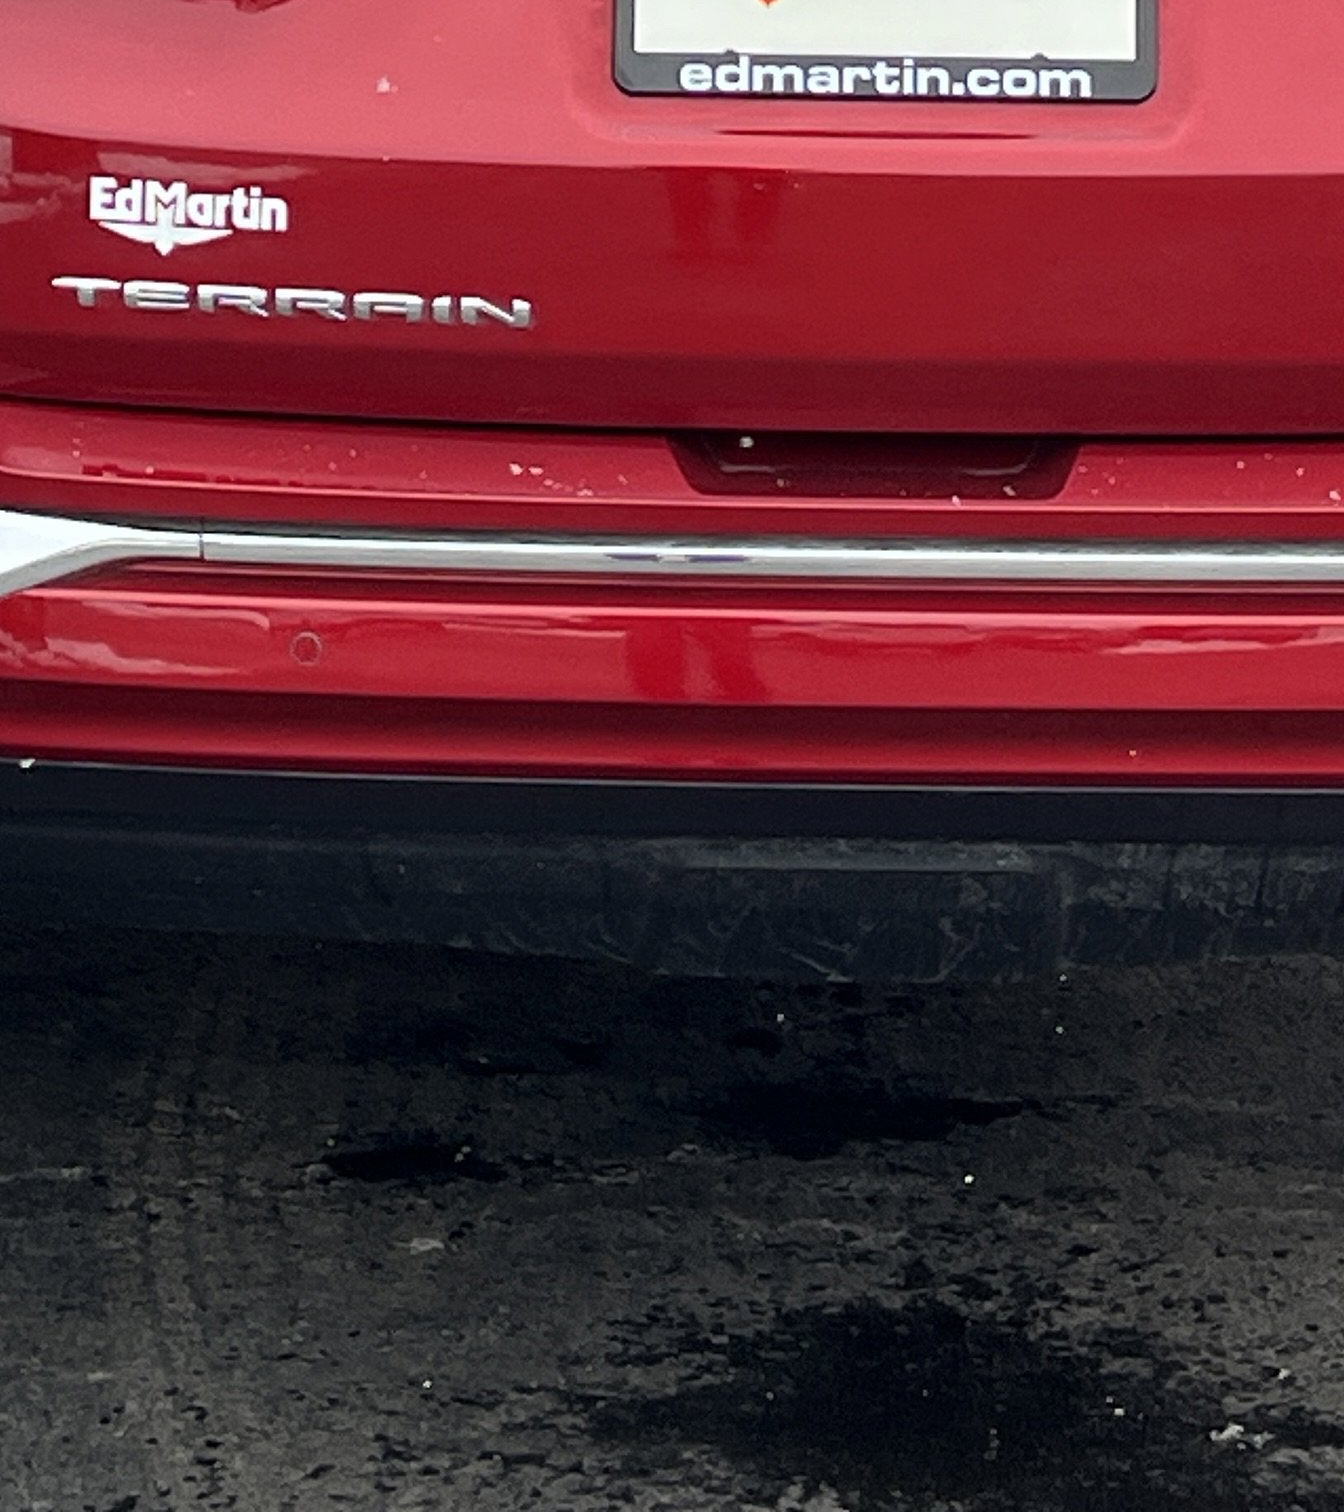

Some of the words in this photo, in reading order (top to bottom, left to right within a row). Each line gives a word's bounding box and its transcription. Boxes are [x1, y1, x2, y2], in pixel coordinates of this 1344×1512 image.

[678, 56, 1093, 98] edmartin.com
[88, 175, 288, 233] EdMartin
[50, 275, 533, 329] TERRAIN
